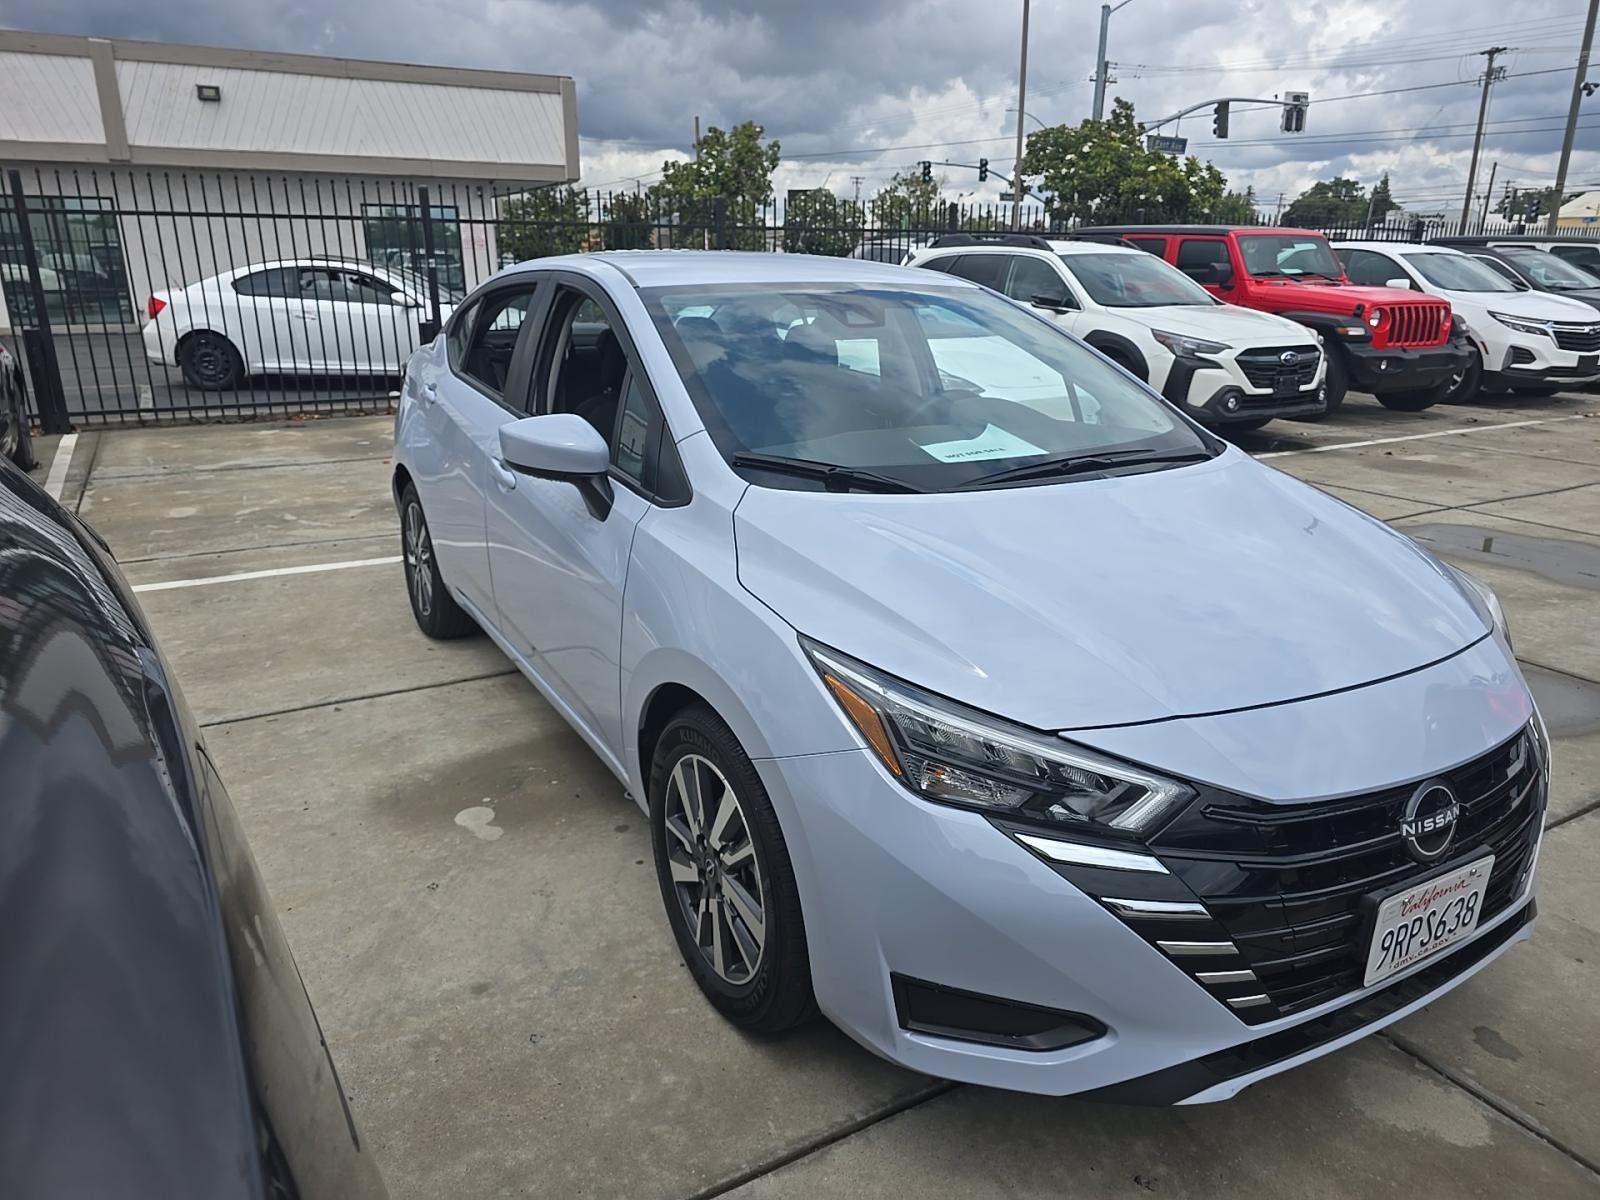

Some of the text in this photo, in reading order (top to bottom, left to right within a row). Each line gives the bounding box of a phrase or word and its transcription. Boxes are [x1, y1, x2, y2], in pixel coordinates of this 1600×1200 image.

[679, 728, 720, 763] KUMHO
[1402, 802, 1460, 837] NISSAN
[1401, 877, 1471, 917] California
[1375, 890, 1479, 971] 9RPS638
